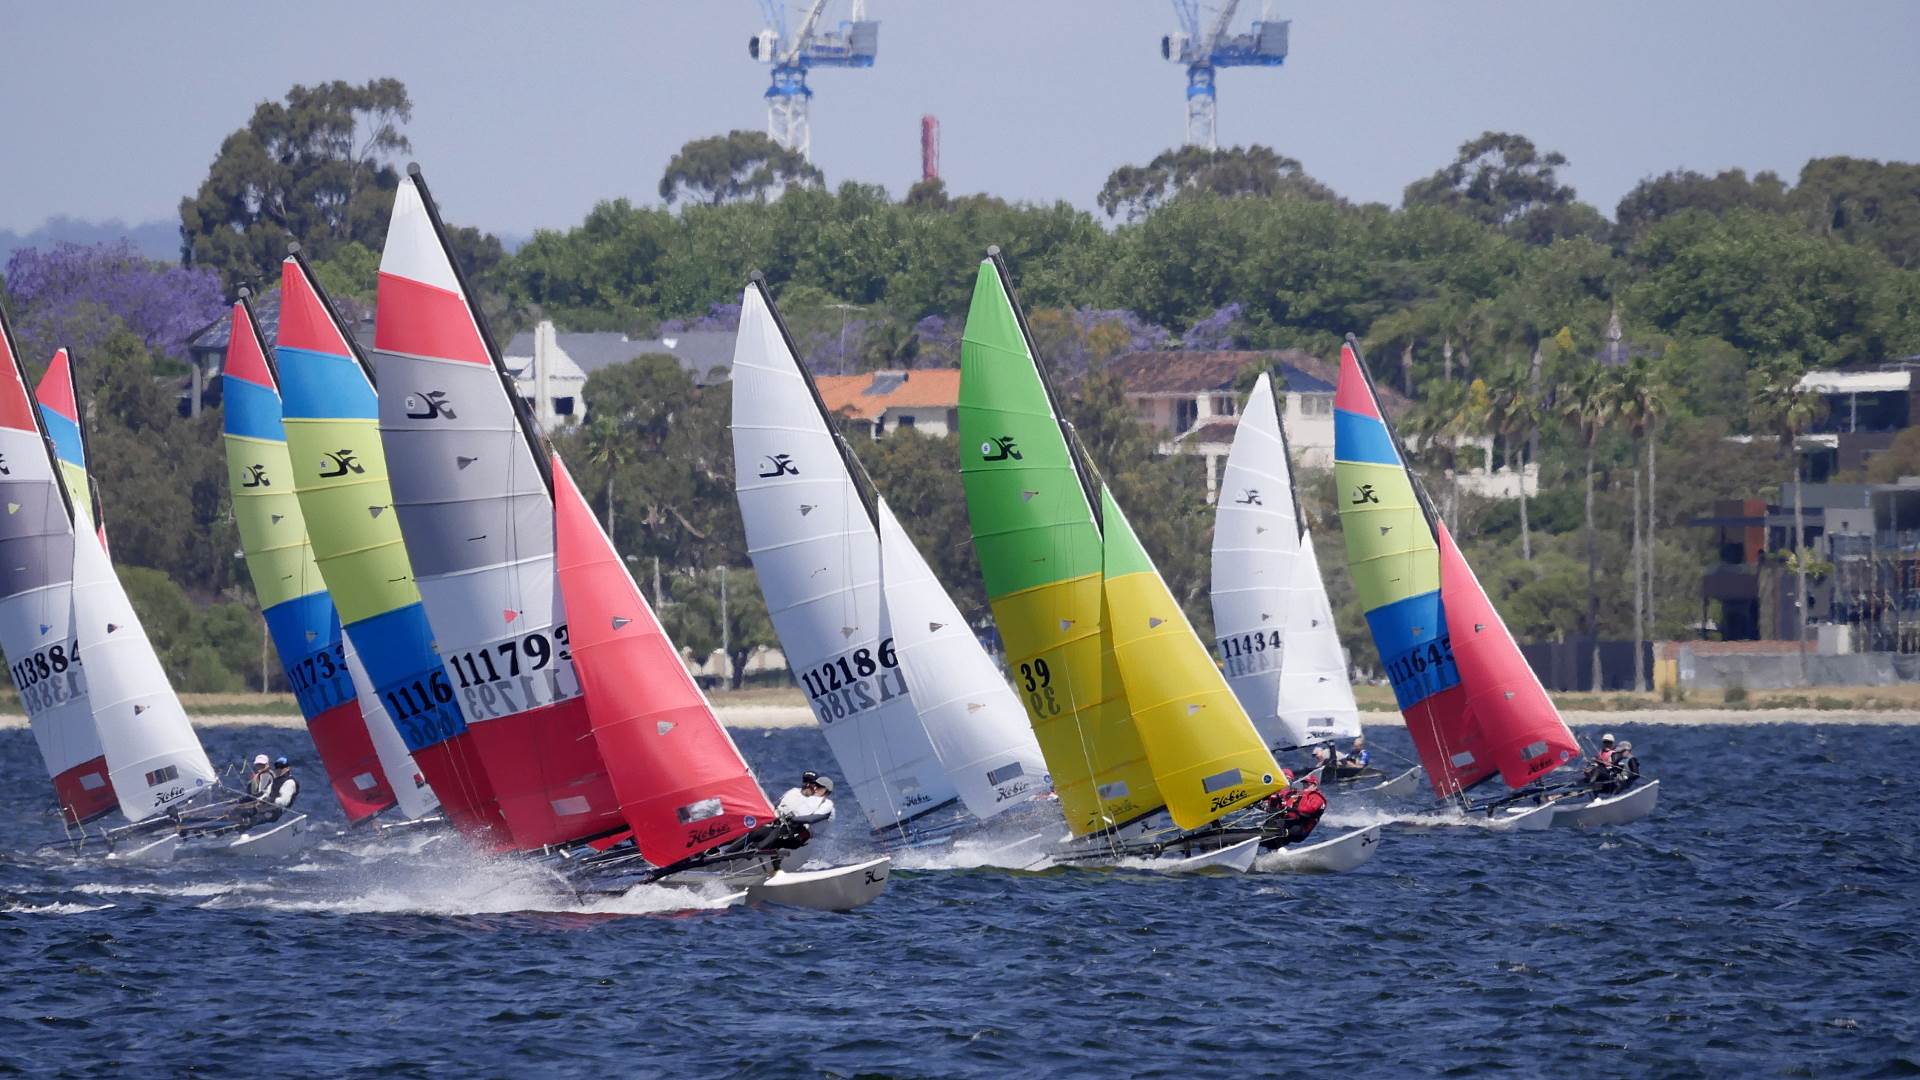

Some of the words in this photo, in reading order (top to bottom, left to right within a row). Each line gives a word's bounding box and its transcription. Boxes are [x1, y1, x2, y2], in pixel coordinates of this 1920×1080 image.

[1222, 630, 1281, 658] 11434
[13, 639, 82, 691] 113884
[802, 638, 898, 699] 112186
[1020, 658, 1050, 692] 39
[154, 786, 185, 808] Hobie
[996, 782, 1030, 803] Hobie
[1210, 789, 1249, 813] Hobie
[686, 822, 731, 848] Hobie
